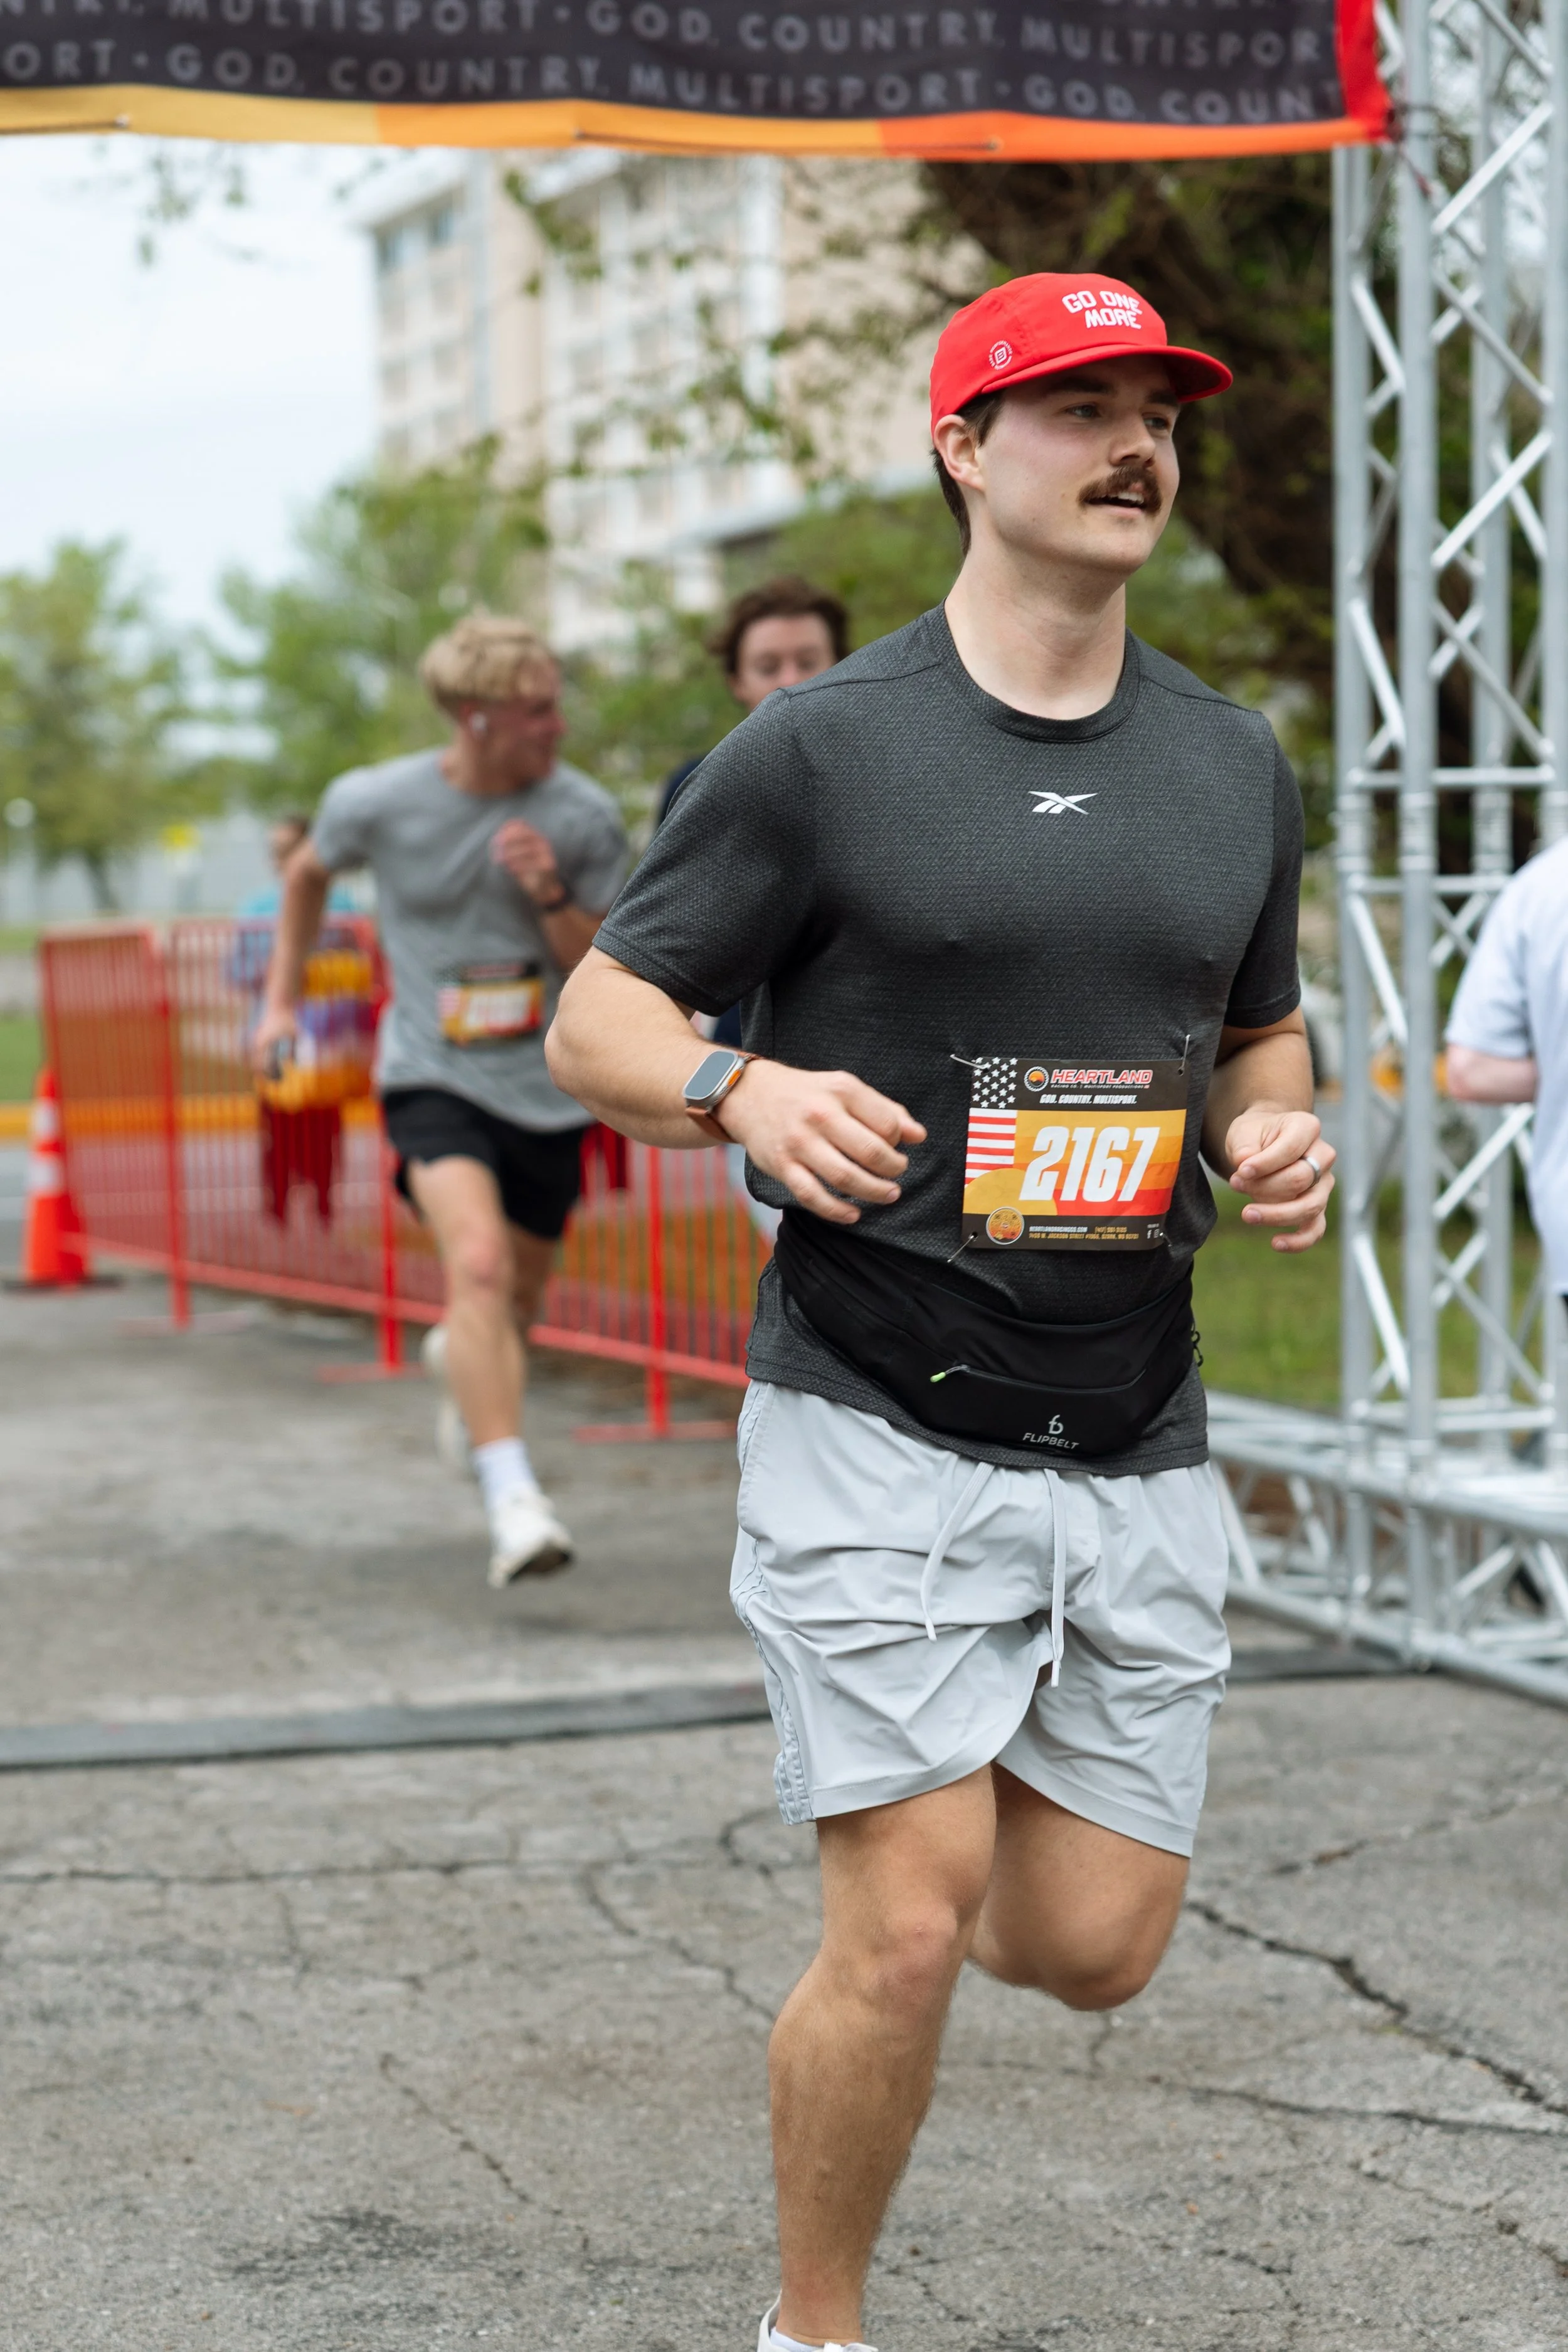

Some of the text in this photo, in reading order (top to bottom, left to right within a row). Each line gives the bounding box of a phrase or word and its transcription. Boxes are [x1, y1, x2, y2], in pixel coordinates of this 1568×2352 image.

[628, 65, 981, 113] MULTISPORT
[1061, 290, 1143, 315] GO ONE
[1084, 307, 1142, 330] MORE
[1050, 1069, 1153, 1084] HEARTLAND
[1058, 1094, 1092, 1104] COUNTRY.
[1093, 1094, 1138, 1104] MULTISPORT.
[1019, 1126, 1161, 1202] 2167
[1022, 1433, 1079, 1449] FLIPBELT
